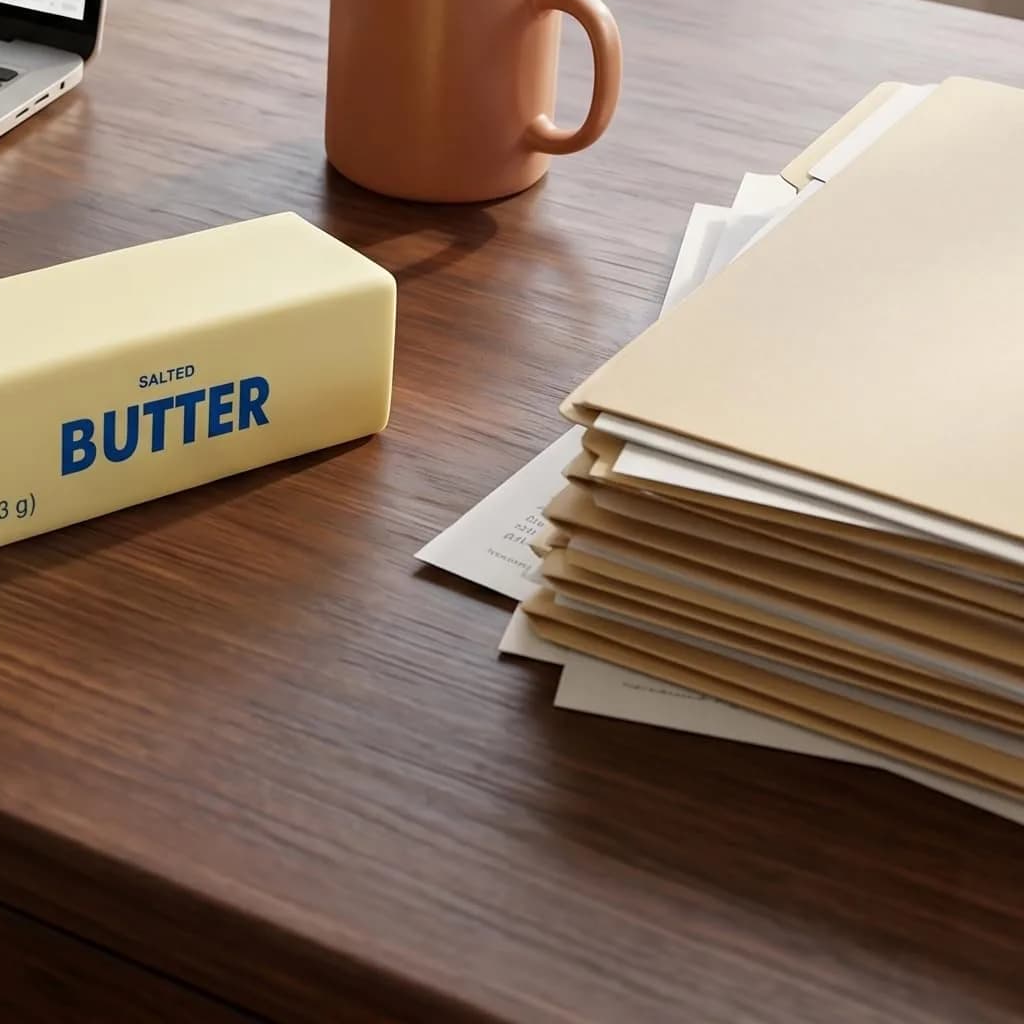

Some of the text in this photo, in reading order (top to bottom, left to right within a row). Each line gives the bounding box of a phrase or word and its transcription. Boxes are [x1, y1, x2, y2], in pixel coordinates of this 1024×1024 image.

[138, 364, 195, 389] SALTED
[60, 375, 270, 476] BUTTER
[15, 493, 36, 518] g)
